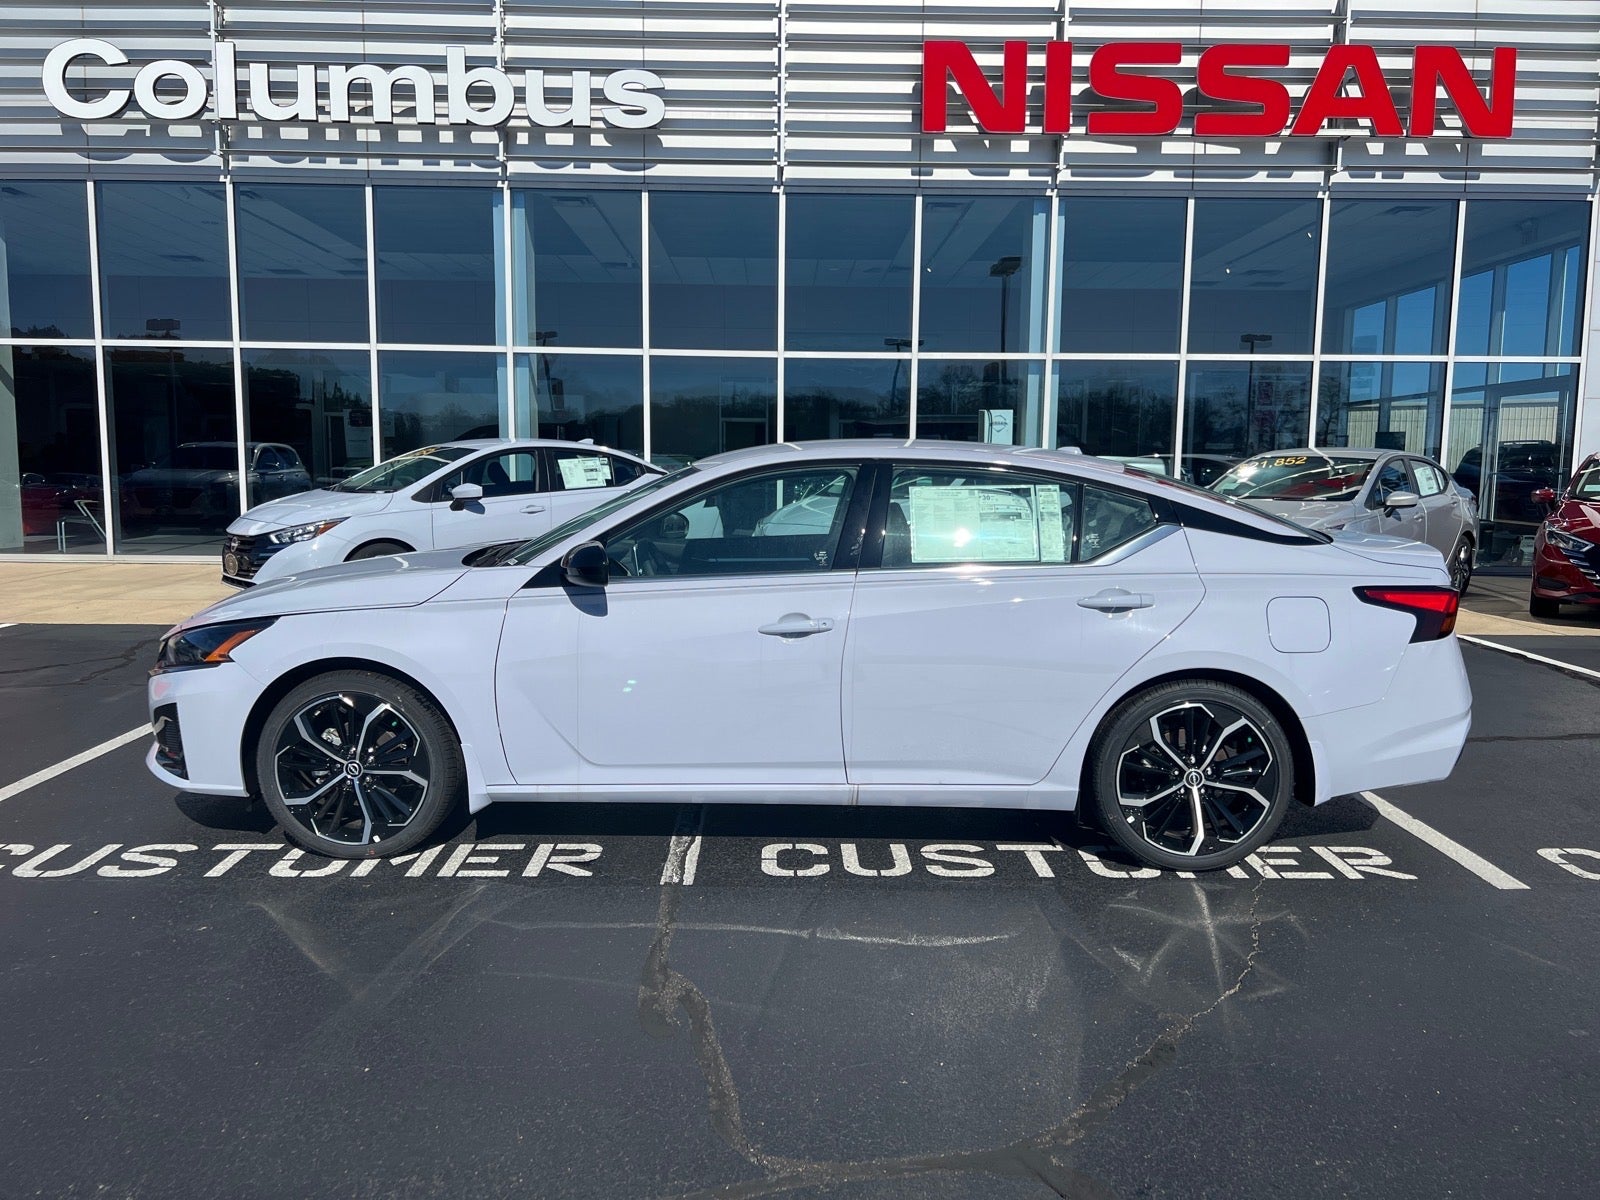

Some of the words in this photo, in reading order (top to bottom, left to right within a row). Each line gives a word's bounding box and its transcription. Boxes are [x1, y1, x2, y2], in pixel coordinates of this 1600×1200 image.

[41, 38, 666, 128] Columbus
[921, 40, 1517, 138] NISSAN
[761, 843, 1418, 879] CUSTOER
